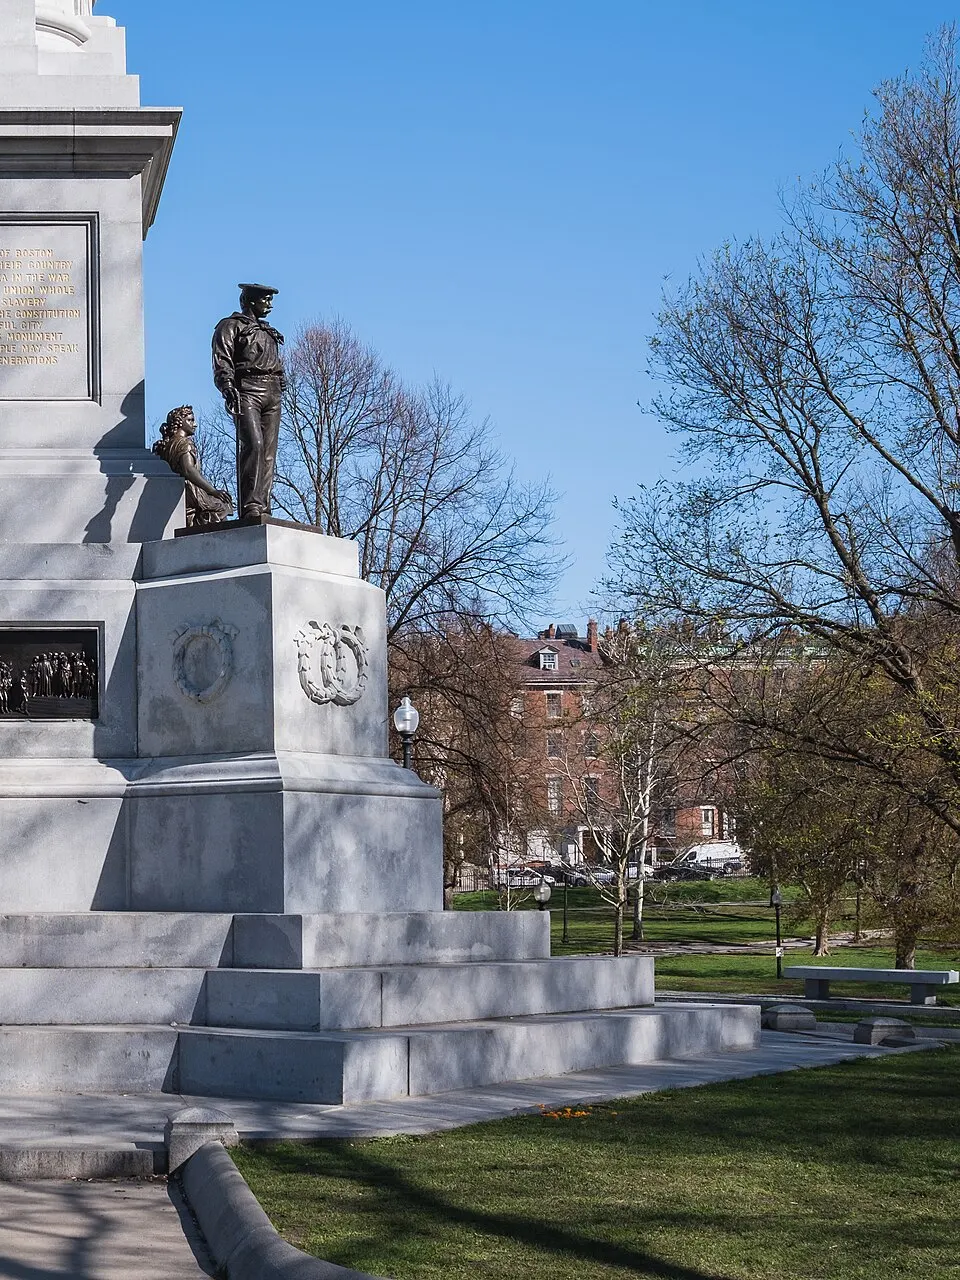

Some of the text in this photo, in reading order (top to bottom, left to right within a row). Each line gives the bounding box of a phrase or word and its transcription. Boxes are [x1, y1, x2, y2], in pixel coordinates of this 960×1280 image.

[0, 249, 10, 257] OF
[16, 249, 53, 257] BOSTON
[28, 261, 73, 269] COUNTRY
[12, 274, 22, 282] IN
[26, 274, 44, 282] THE
[49, 274, 69, 282] WAR
[4, 286, 35, 294] UNION
[40, 286, 74, 294] WHOLE
[1, 298, 46, 306] SLAVERY
[15, 310, 80, 318] CONSTITUTION
[22, 321, 43, 330] CITY
[7, 333, 63, 341] MONUMENT
[22, 344, 42, 353] MAY
[47, 344, 79, 353] SPEAK
